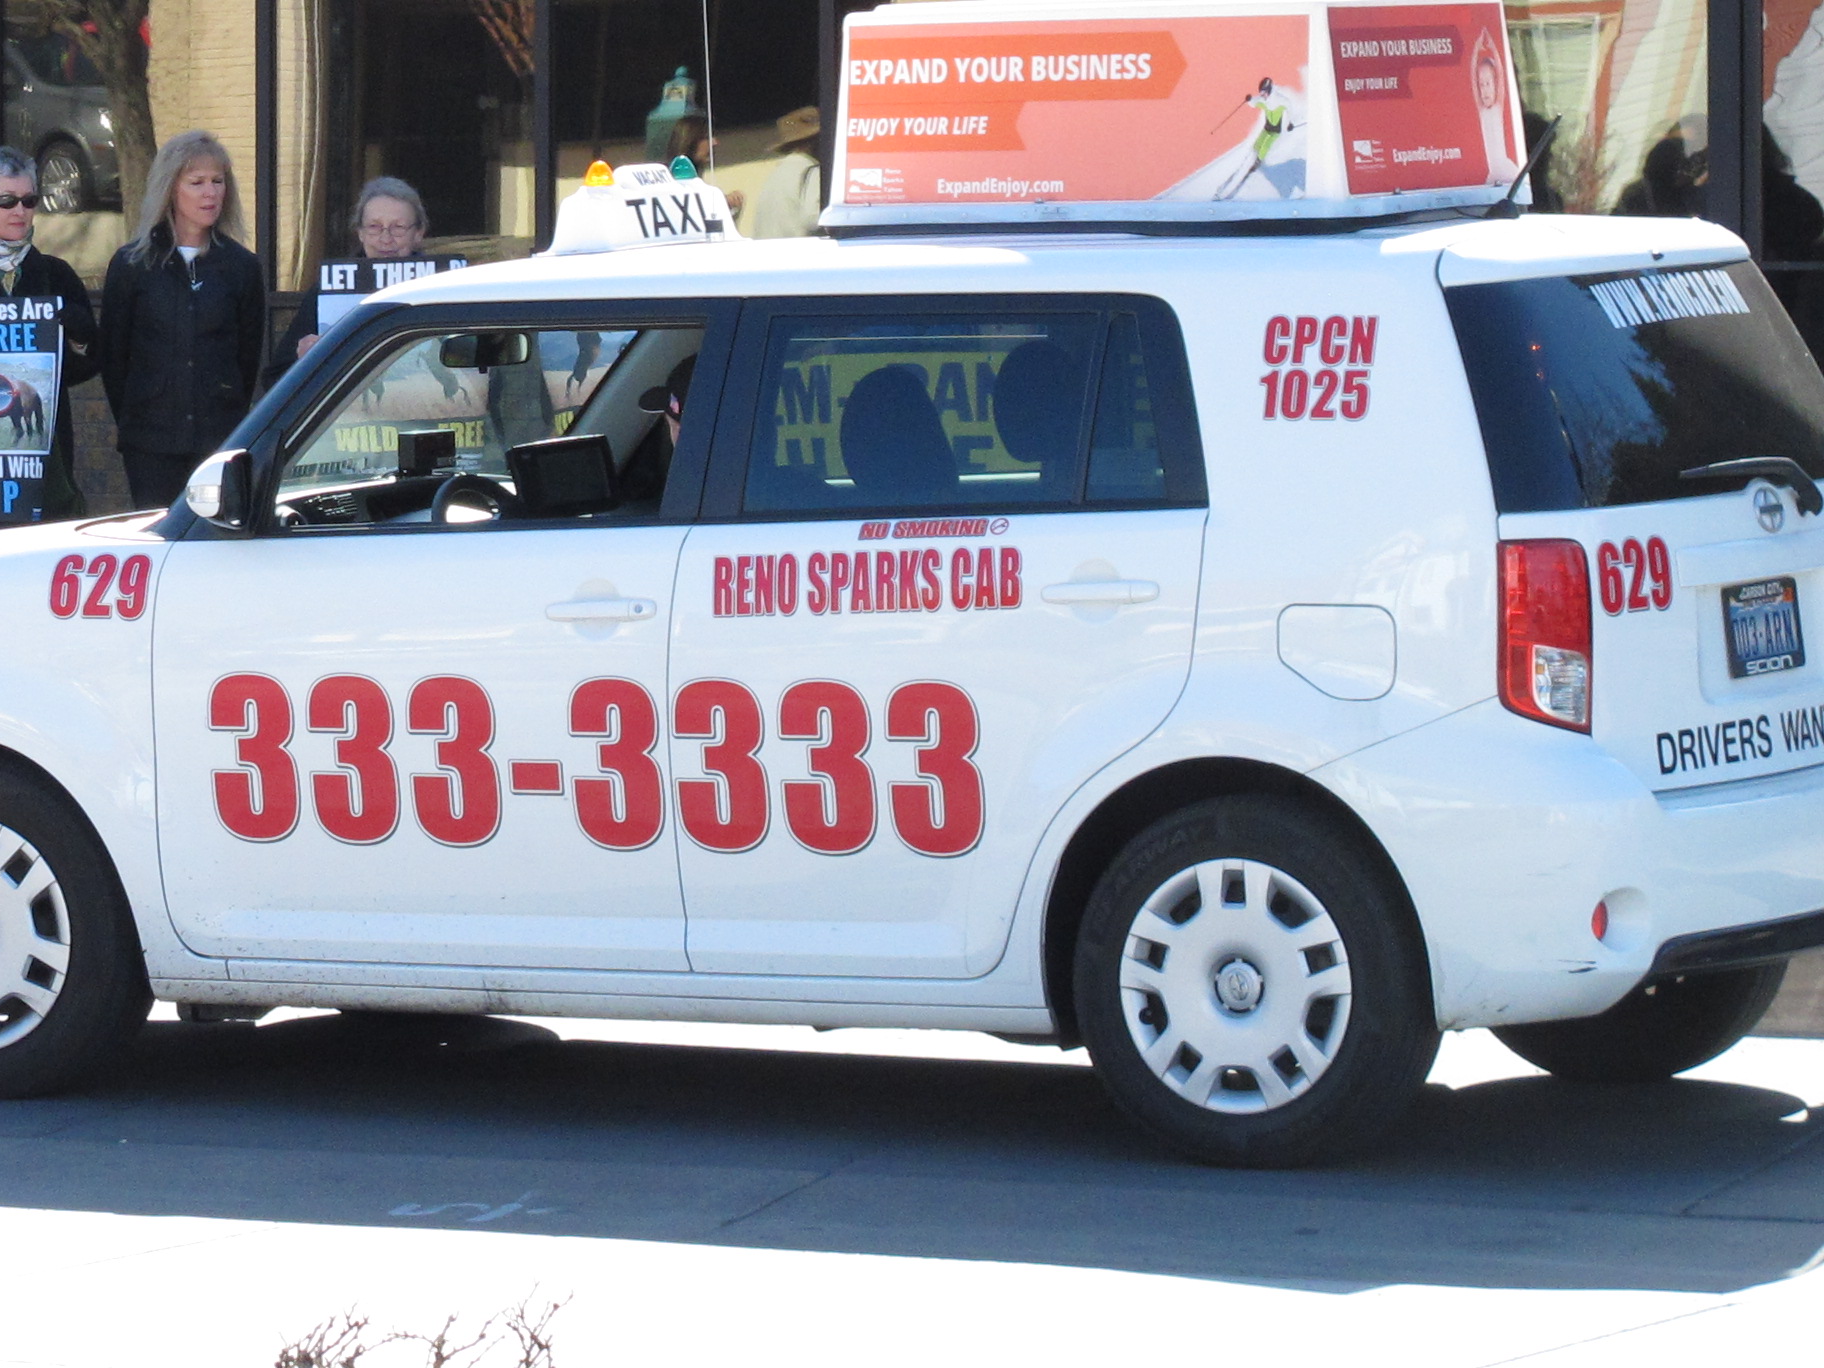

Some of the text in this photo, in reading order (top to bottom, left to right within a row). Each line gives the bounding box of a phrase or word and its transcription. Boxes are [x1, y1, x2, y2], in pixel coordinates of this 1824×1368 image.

[1340, 38, 1453, 58] EXPAND YOUR BUSINESS
[849, 52, 1152, 86] EXPAND YOUR BUSINESS
[847, 115, 988, 141] ENJOY YOUR LIFE
[1392, 146, 1462, 166] ExpandEnjoy.com
[632, 169, 671, 186] VACANT
[937, 178, 1064, 198] ExpandEnjoy.com
[624, 193, 706, 238] TAXI
[321, 264, 358, 290] LET
[22, 297, 54, 320] Are
[1262, 315, 1379, 366] CPCN
[1259, 368, 1371, 422] 1025
[334, 425, 398, 453] WILD
[7, 456, 43, 479] With
[858, 518, 988, 539] NO SMOKING
[49, 552, 153, 619] 629
[713, 546, 1023, 617] RENO SPARKS CAB
[1597, 534, 1673, 615] 629
[1656, 714, 1773, 775] DRIVERS
[208, 671, 984, 857] 333-3333
